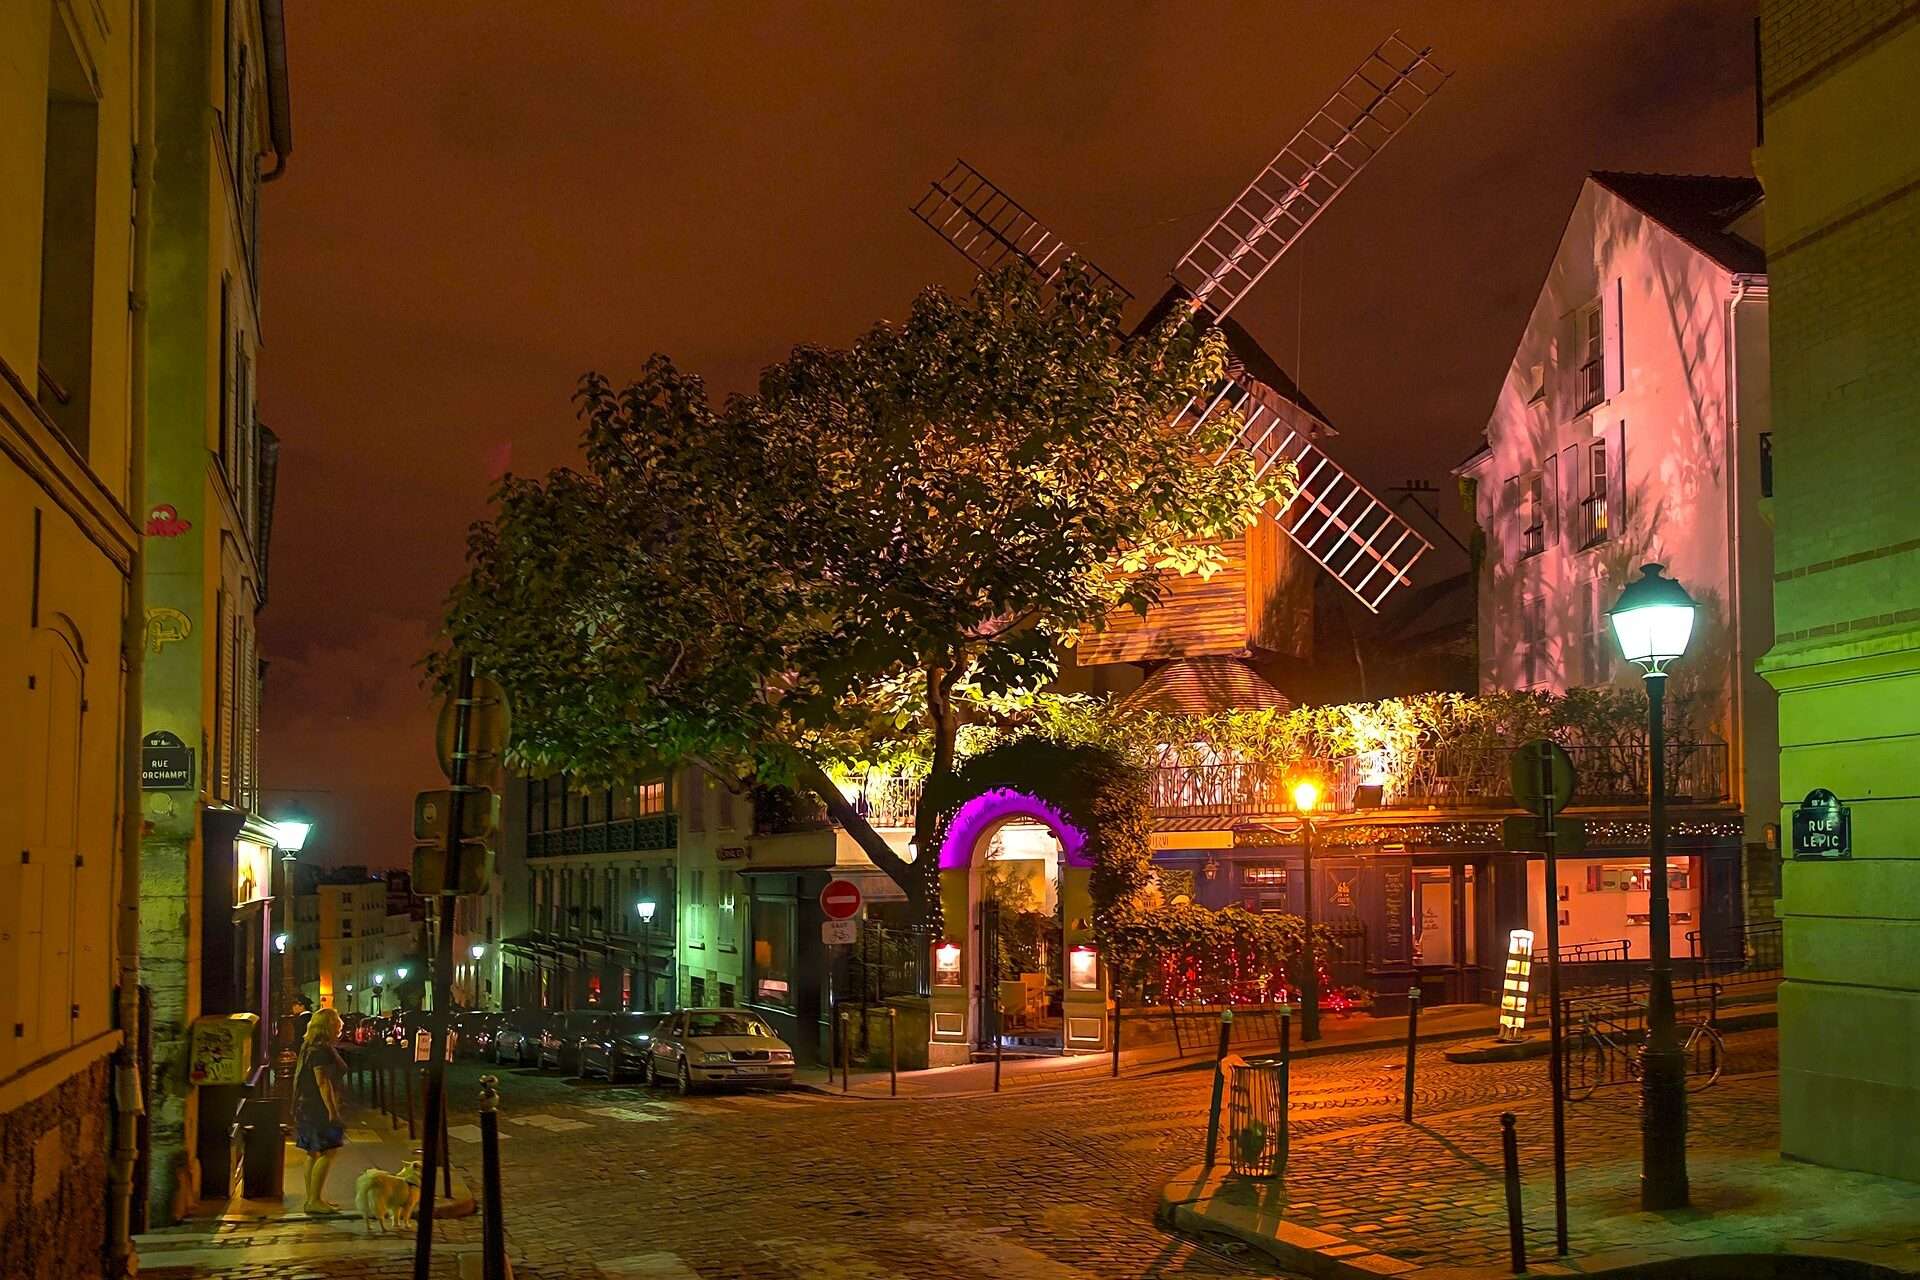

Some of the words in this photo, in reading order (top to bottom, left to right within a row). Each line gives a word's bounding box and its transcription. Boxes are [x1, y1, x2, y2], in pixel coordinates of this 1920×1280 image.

[151, 760, 169, 768] RUE
[1808, 820, 1833, 832] RUE
[1803, 835, 1839, 847] LEPIC
